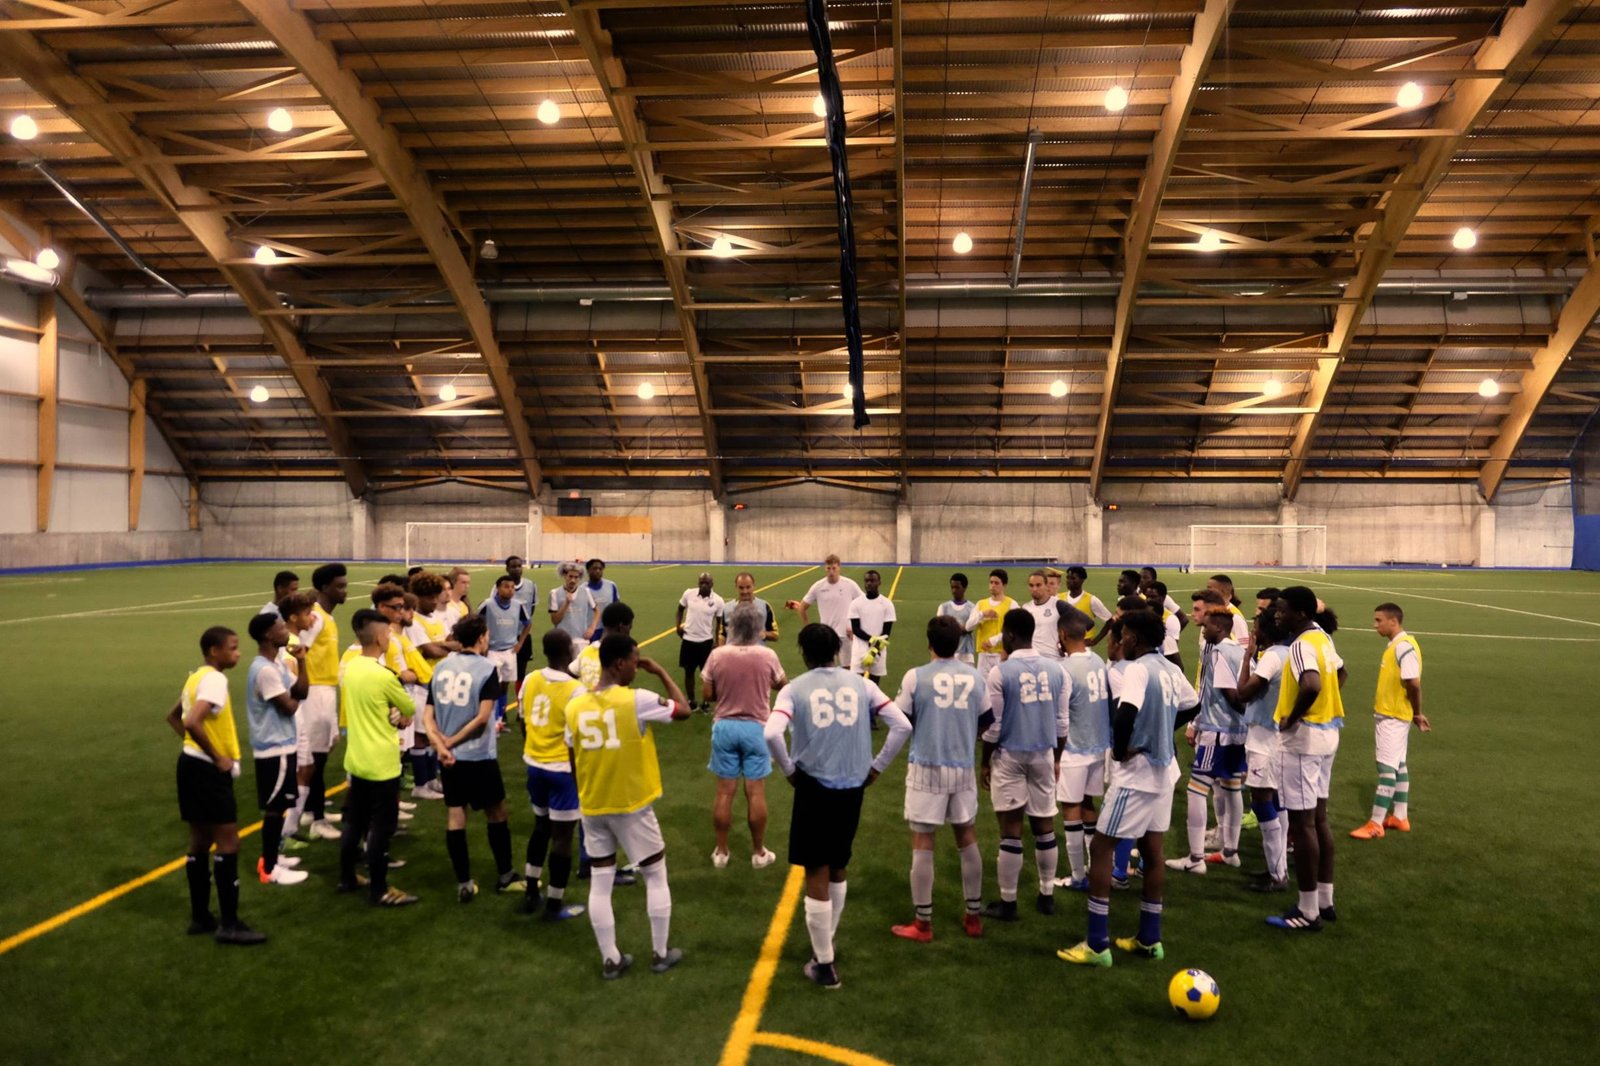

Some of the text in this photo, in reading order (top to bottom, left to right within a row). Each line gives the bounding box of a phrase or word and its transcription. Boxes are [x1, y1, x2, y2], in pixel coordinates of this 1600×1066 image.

[436, 671, 472, 706] 38
[932, 673, 975, 710] 97
[1019, 671, 1052, 704] 21
[1087, 668, 1108, 703] 91
[531, 694, 551, 727] 0
[810, 687, 858, 728] 69
[578, 709, 621, 748] 51
